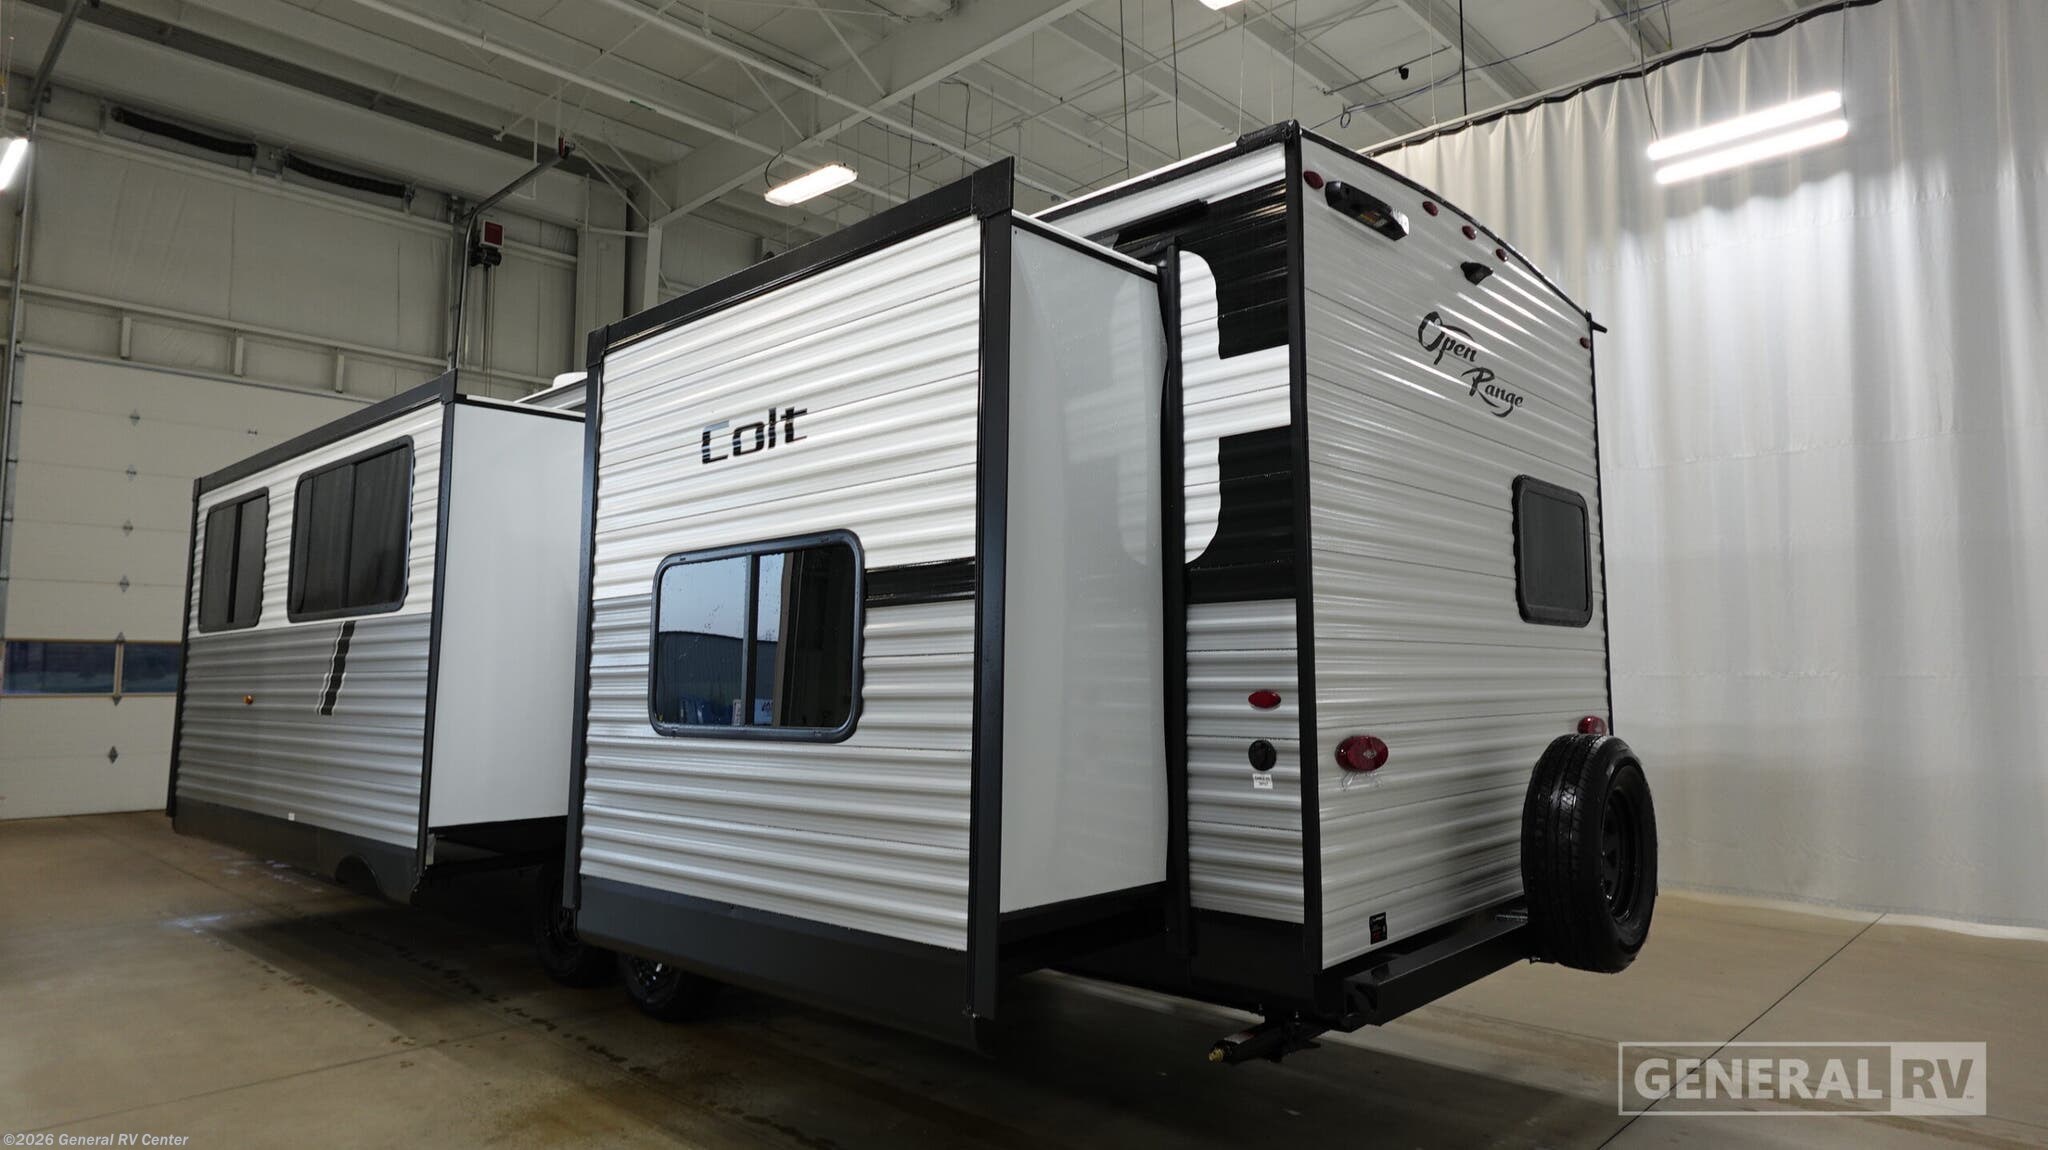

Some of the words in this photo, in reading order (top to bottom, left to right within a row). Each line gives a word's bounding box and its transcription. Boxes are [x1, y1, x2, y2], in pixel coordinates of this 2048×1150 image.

[1418, 311, 1476, 365] Open
[1460, 367, 1523, 418] Range
[702, 406, 808, 464] Colt
